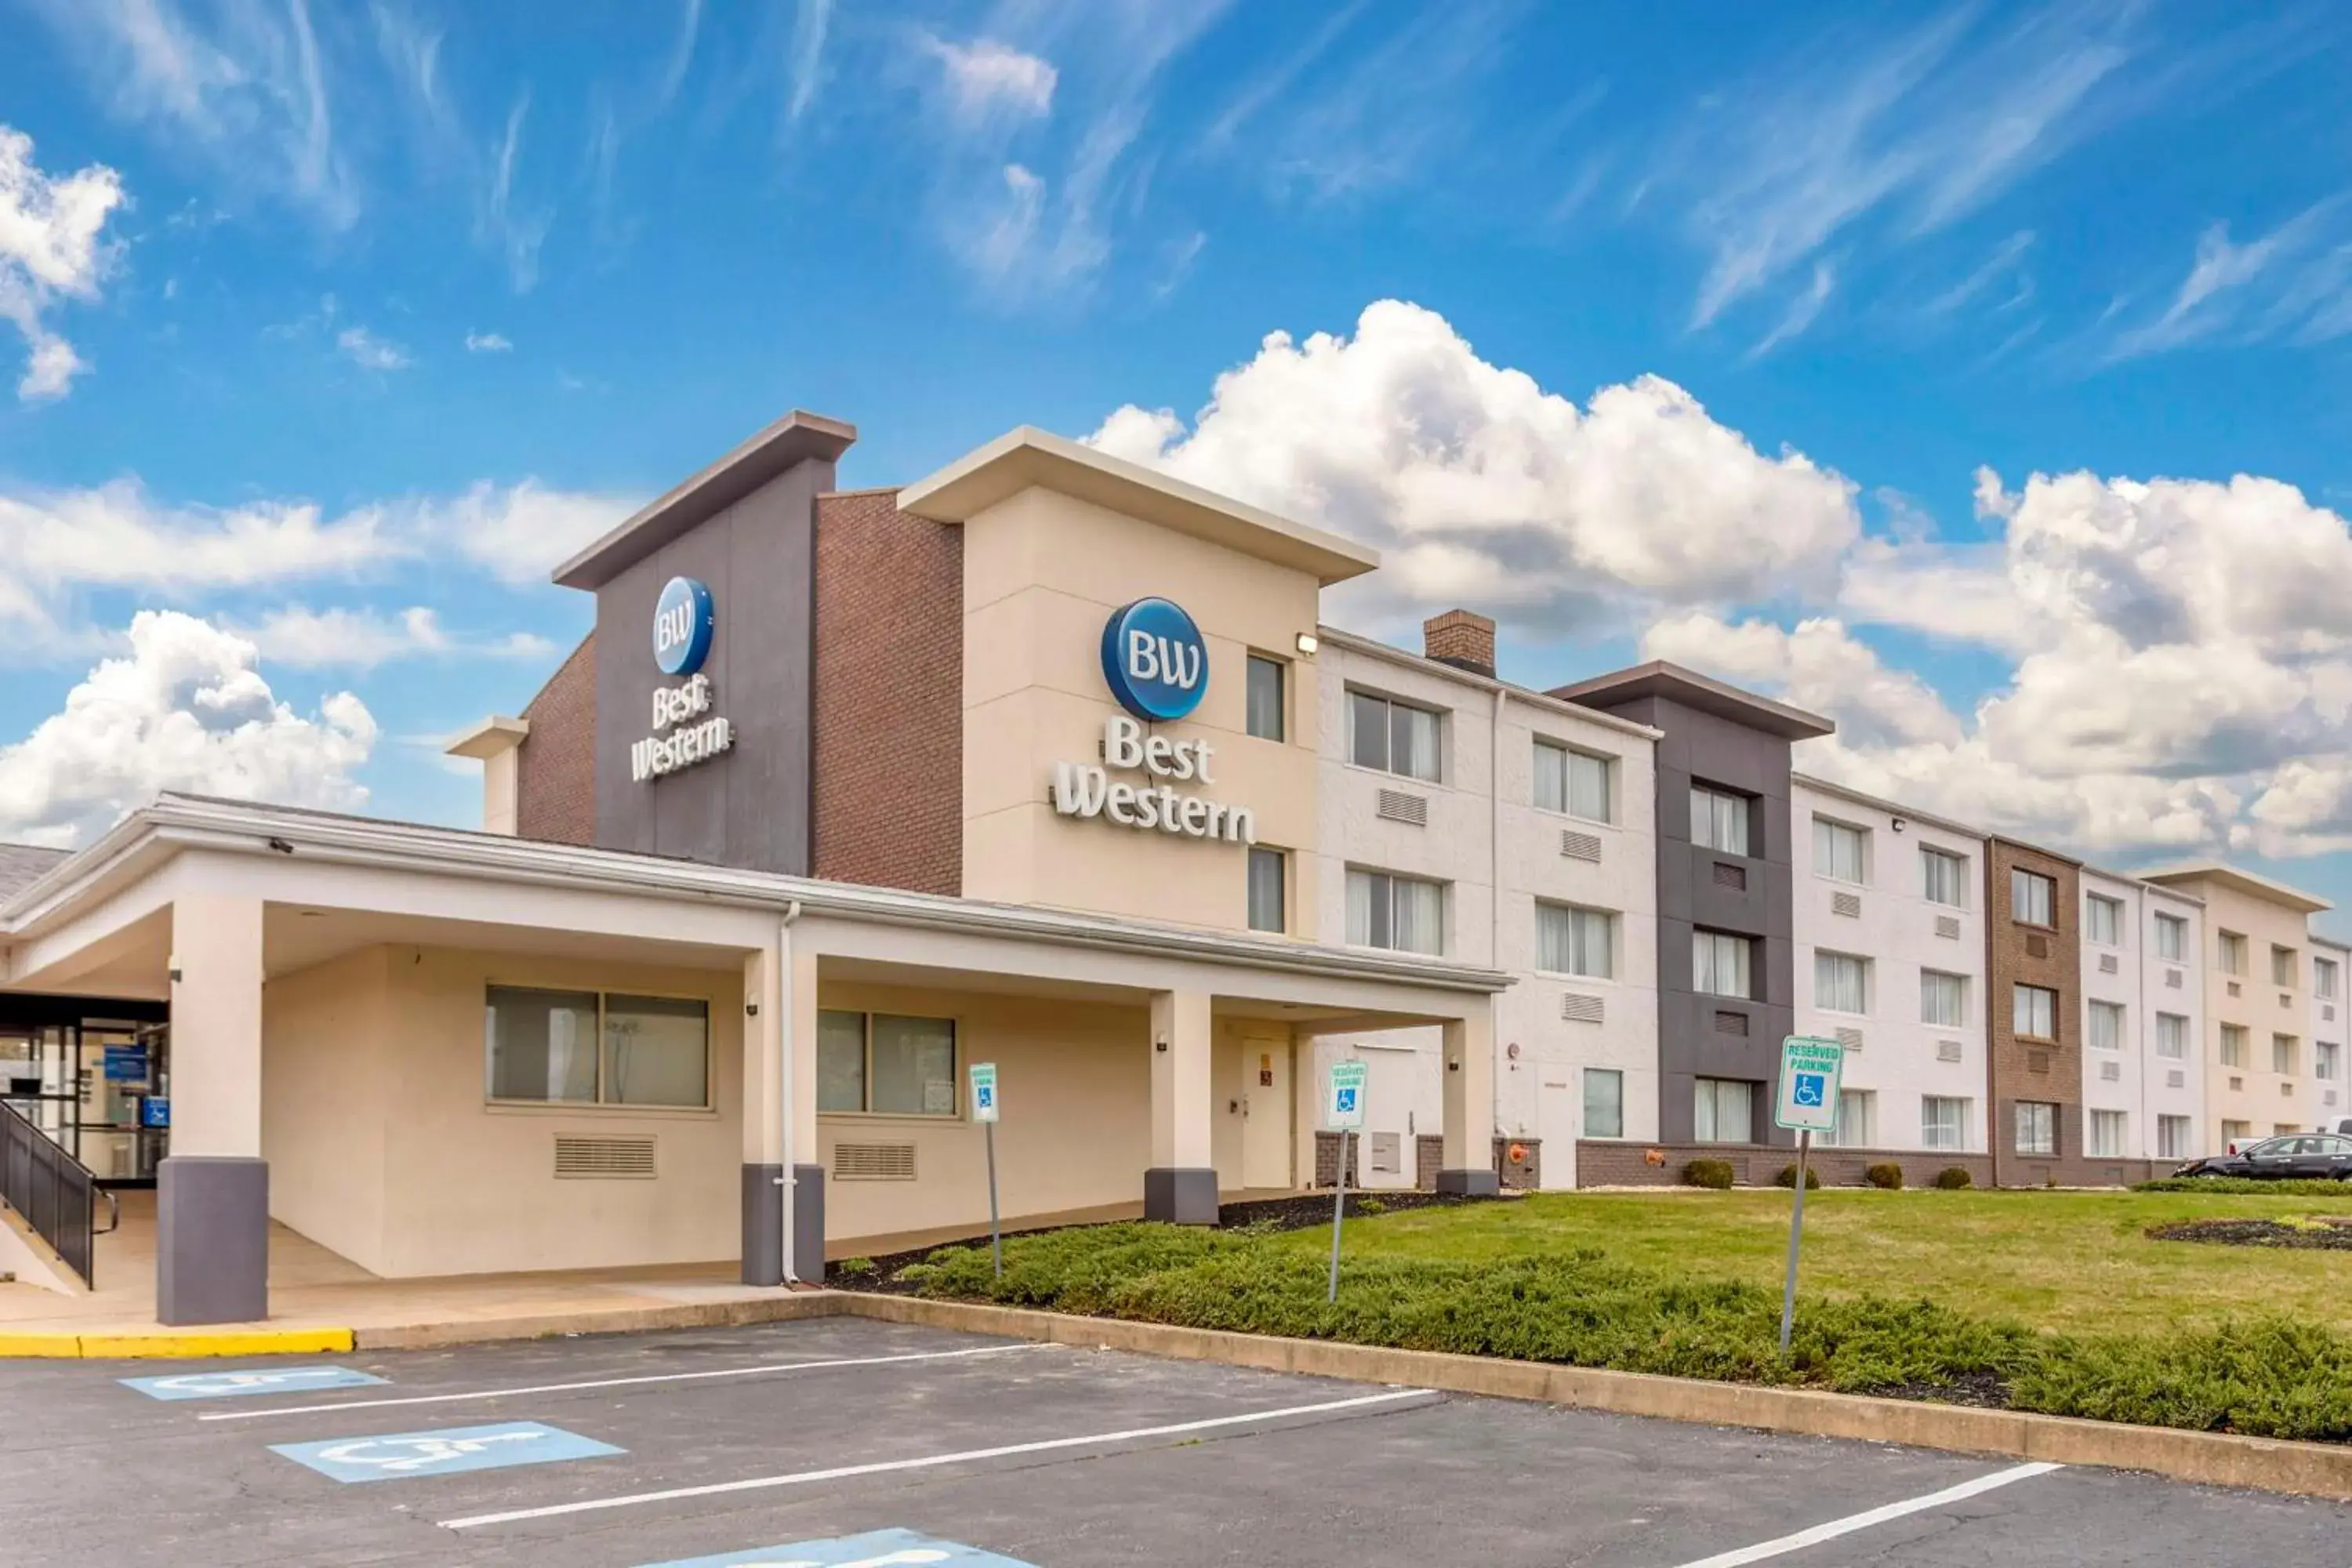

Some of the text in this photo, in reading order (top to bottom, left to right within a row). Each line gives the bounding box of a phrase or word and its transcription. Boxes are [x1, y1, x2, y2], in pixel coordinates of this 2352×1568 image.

[658, 599, 691, 653] BW
[1128, 630, 1200, 690] BW
[652, 672, 710, 730] Best
[631, 717, 730, 782] Western
[1105, 715, 1216, 784] Best
[1053, 760, 1256, 845] Western
[1788, 1045, 1838, 1060] RESERVED
[1790, 1058, 1833, 1073] PARKING
